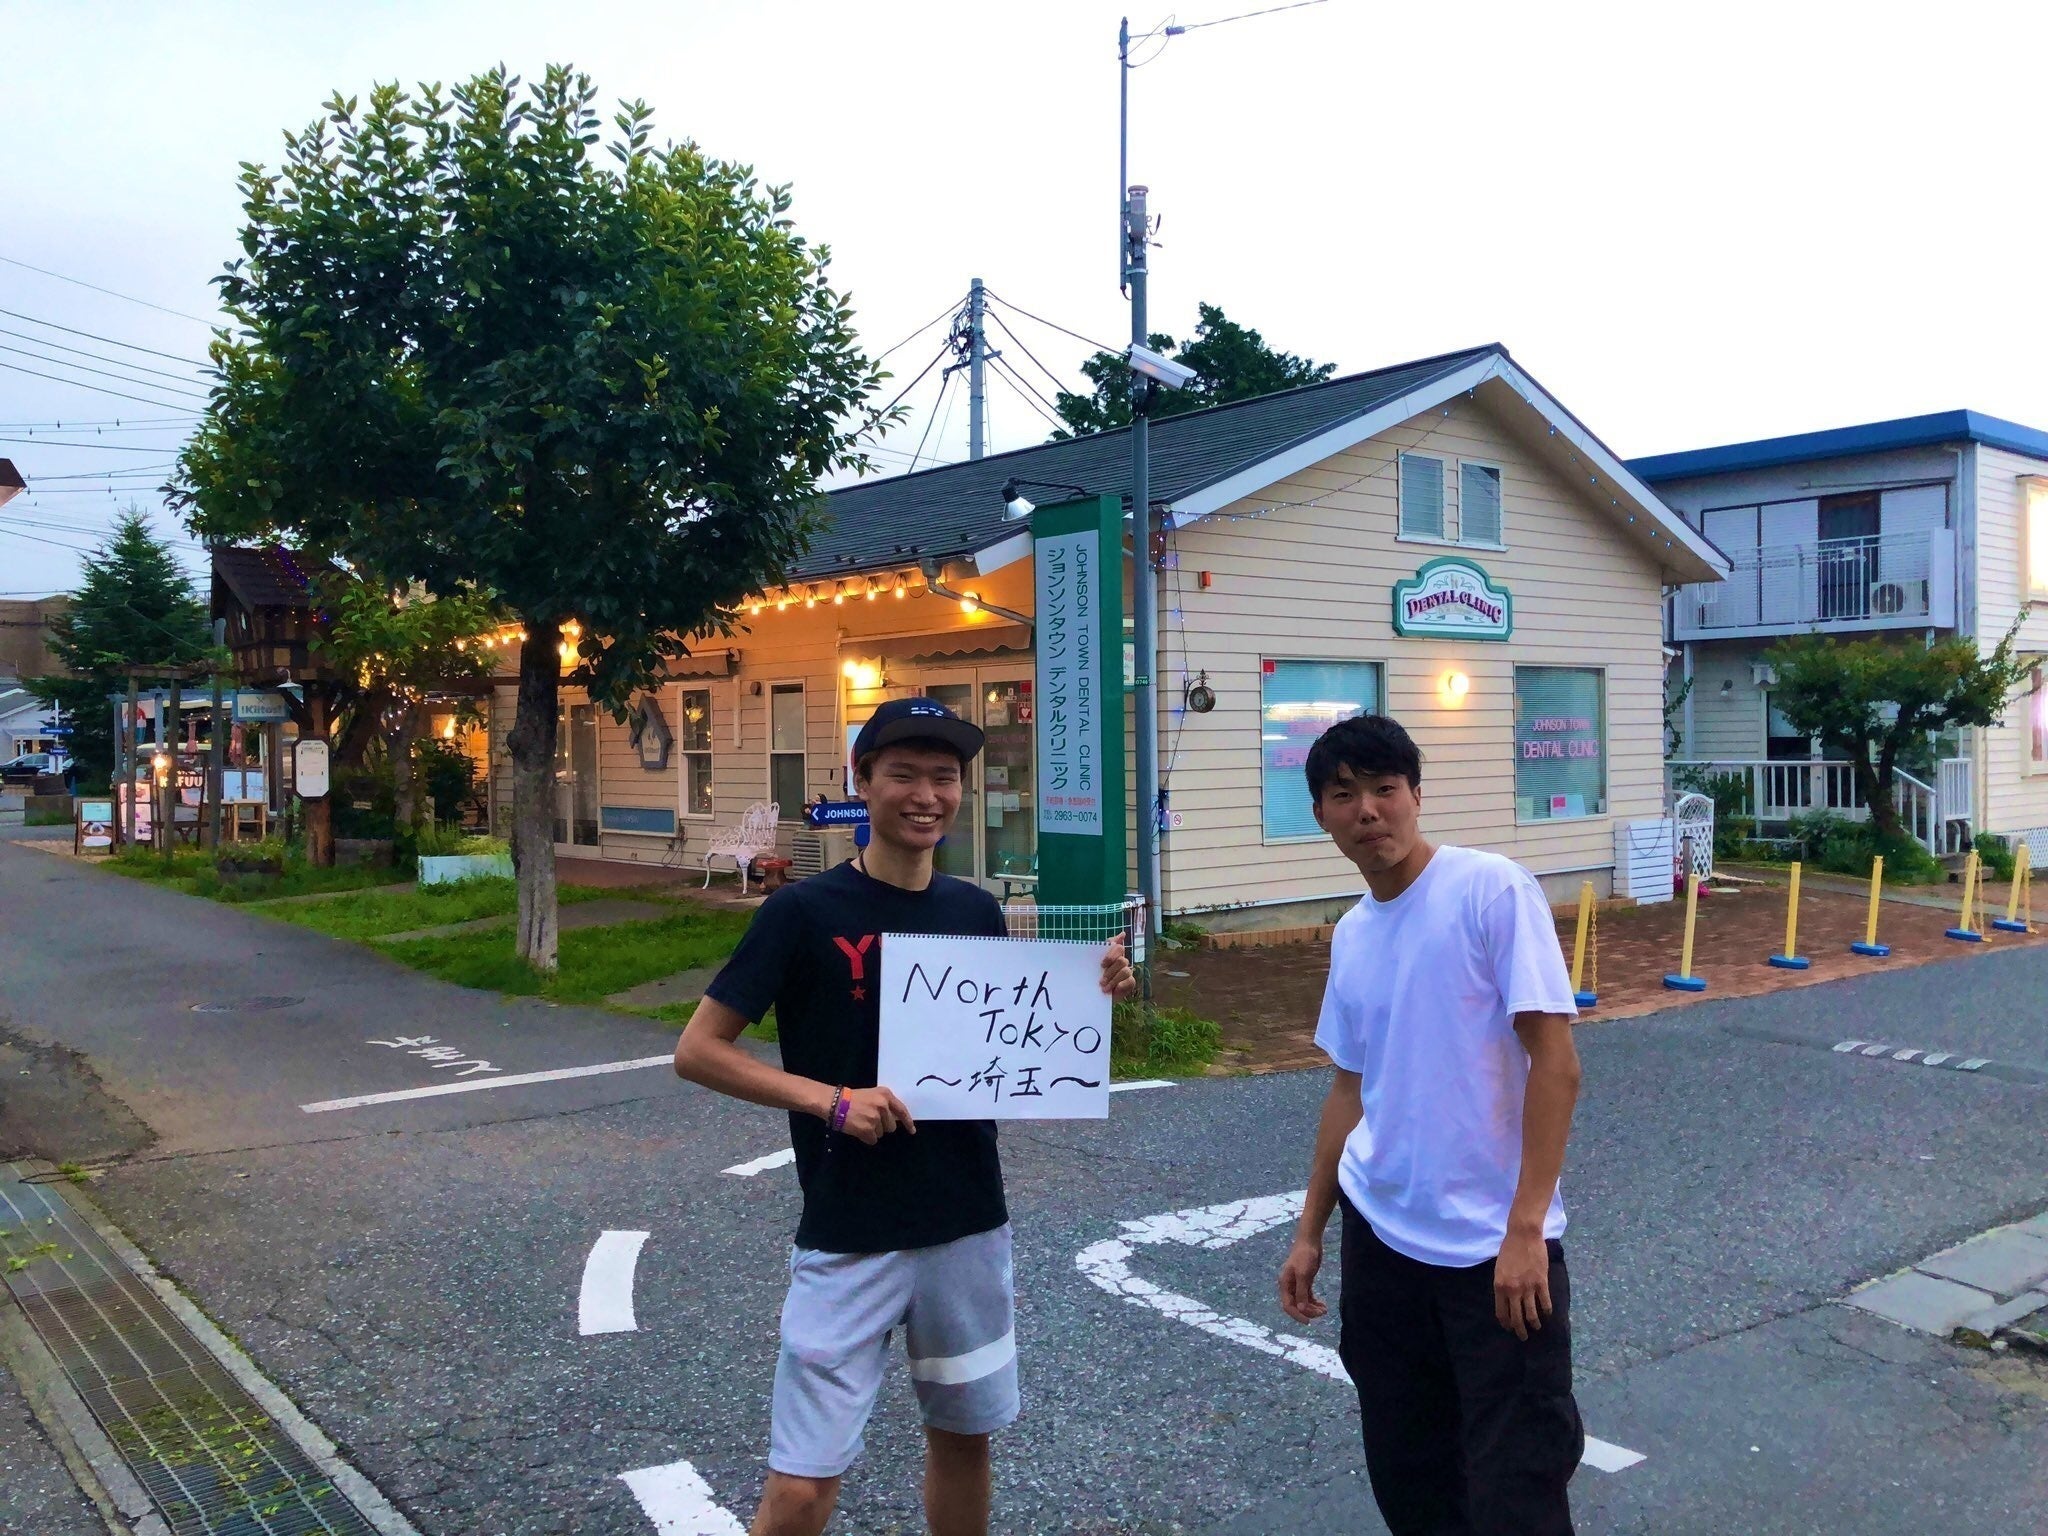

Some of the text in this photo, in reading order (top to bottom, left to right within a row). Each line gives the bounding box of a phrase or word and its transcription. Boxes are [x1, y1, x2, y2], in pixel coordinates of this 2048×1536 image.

[1406, 590, 1460, 619] DENTAL
[1460, 591, 1502, 623] CLINIC
[1048, 548, 1068, 790] ジョンソンタウン デンタルクリニック
[1076, 544, 1091, 791] JOHNSON TOWN DENTAL CLINIC
[1523, 739, 1599, 759] DENTAL CLINIC
[1054, 810, 1098, 822] 2963-0074
[902, 963, 1052, 1010] North
